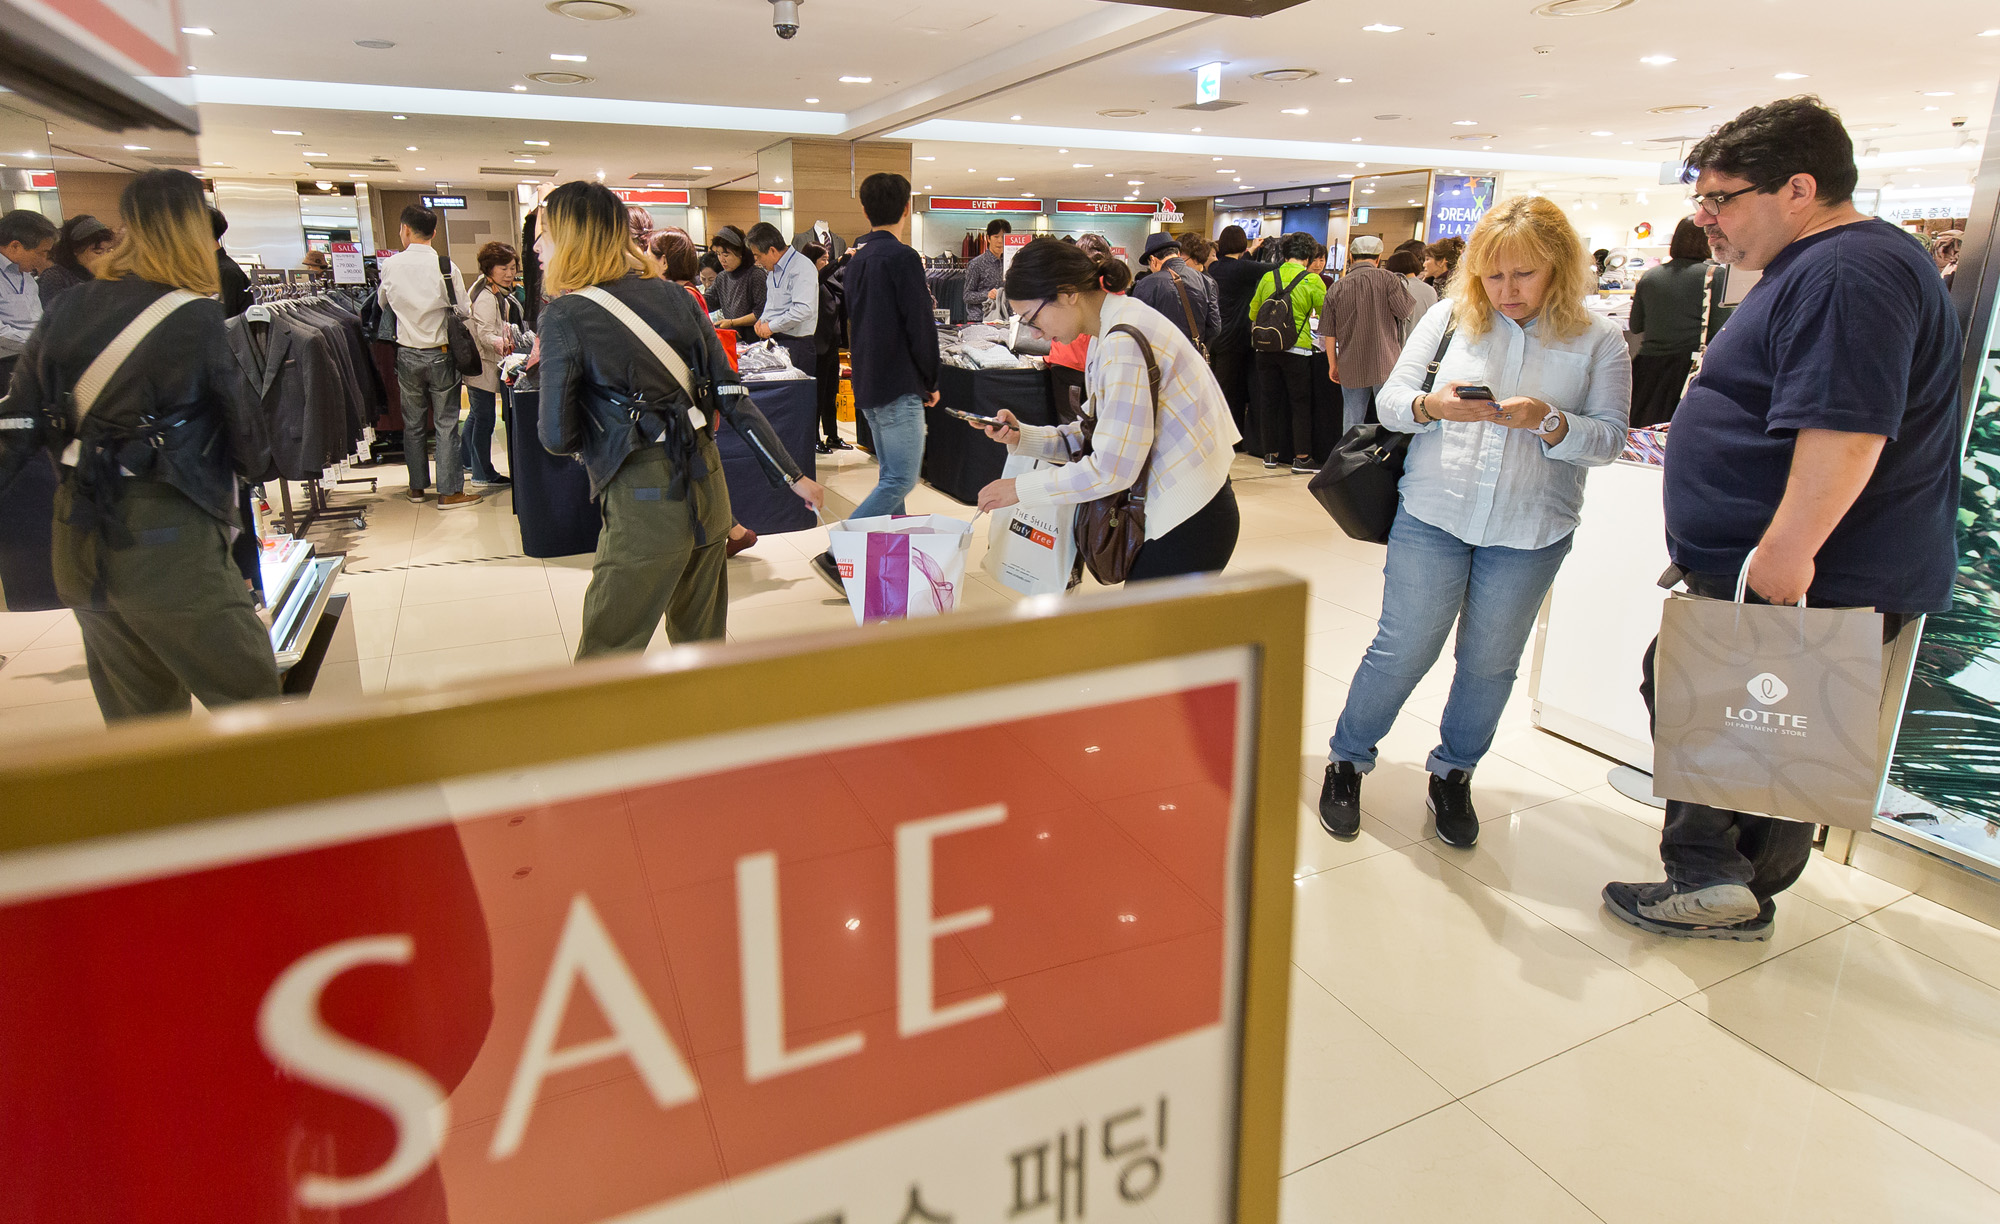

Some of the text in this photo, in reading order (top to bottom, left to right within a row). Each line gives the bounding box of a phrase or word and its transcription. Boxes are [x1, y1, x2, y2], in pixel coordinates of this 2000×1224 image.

[972, 200, 997, 209] EVENT
[1094, 203, 1118, 212] EVENT
[1154, 213, 1183, 222] REDOX
[1439, 207, 1482, 221] DREAM
[1889, 208, 1923, 219] 사은품
[1928, 207, 1951, 218] 증정
[1439, 223, 1471, 235] PLAZ
[1010, 236, 1026, 244] SALE
[338, 244, 356, 252] SALE
[1016, 508, 1059, 534] THE SHILLA
[1012, 521, 1052, 546] duty free
[1725, 706, 1808, 729] LOTTE
[1781, 729, 1807, 737] STORE
[254, 803, 1009, 1209] SALE
[1007, 1094, 1169, 1224] 패딩
